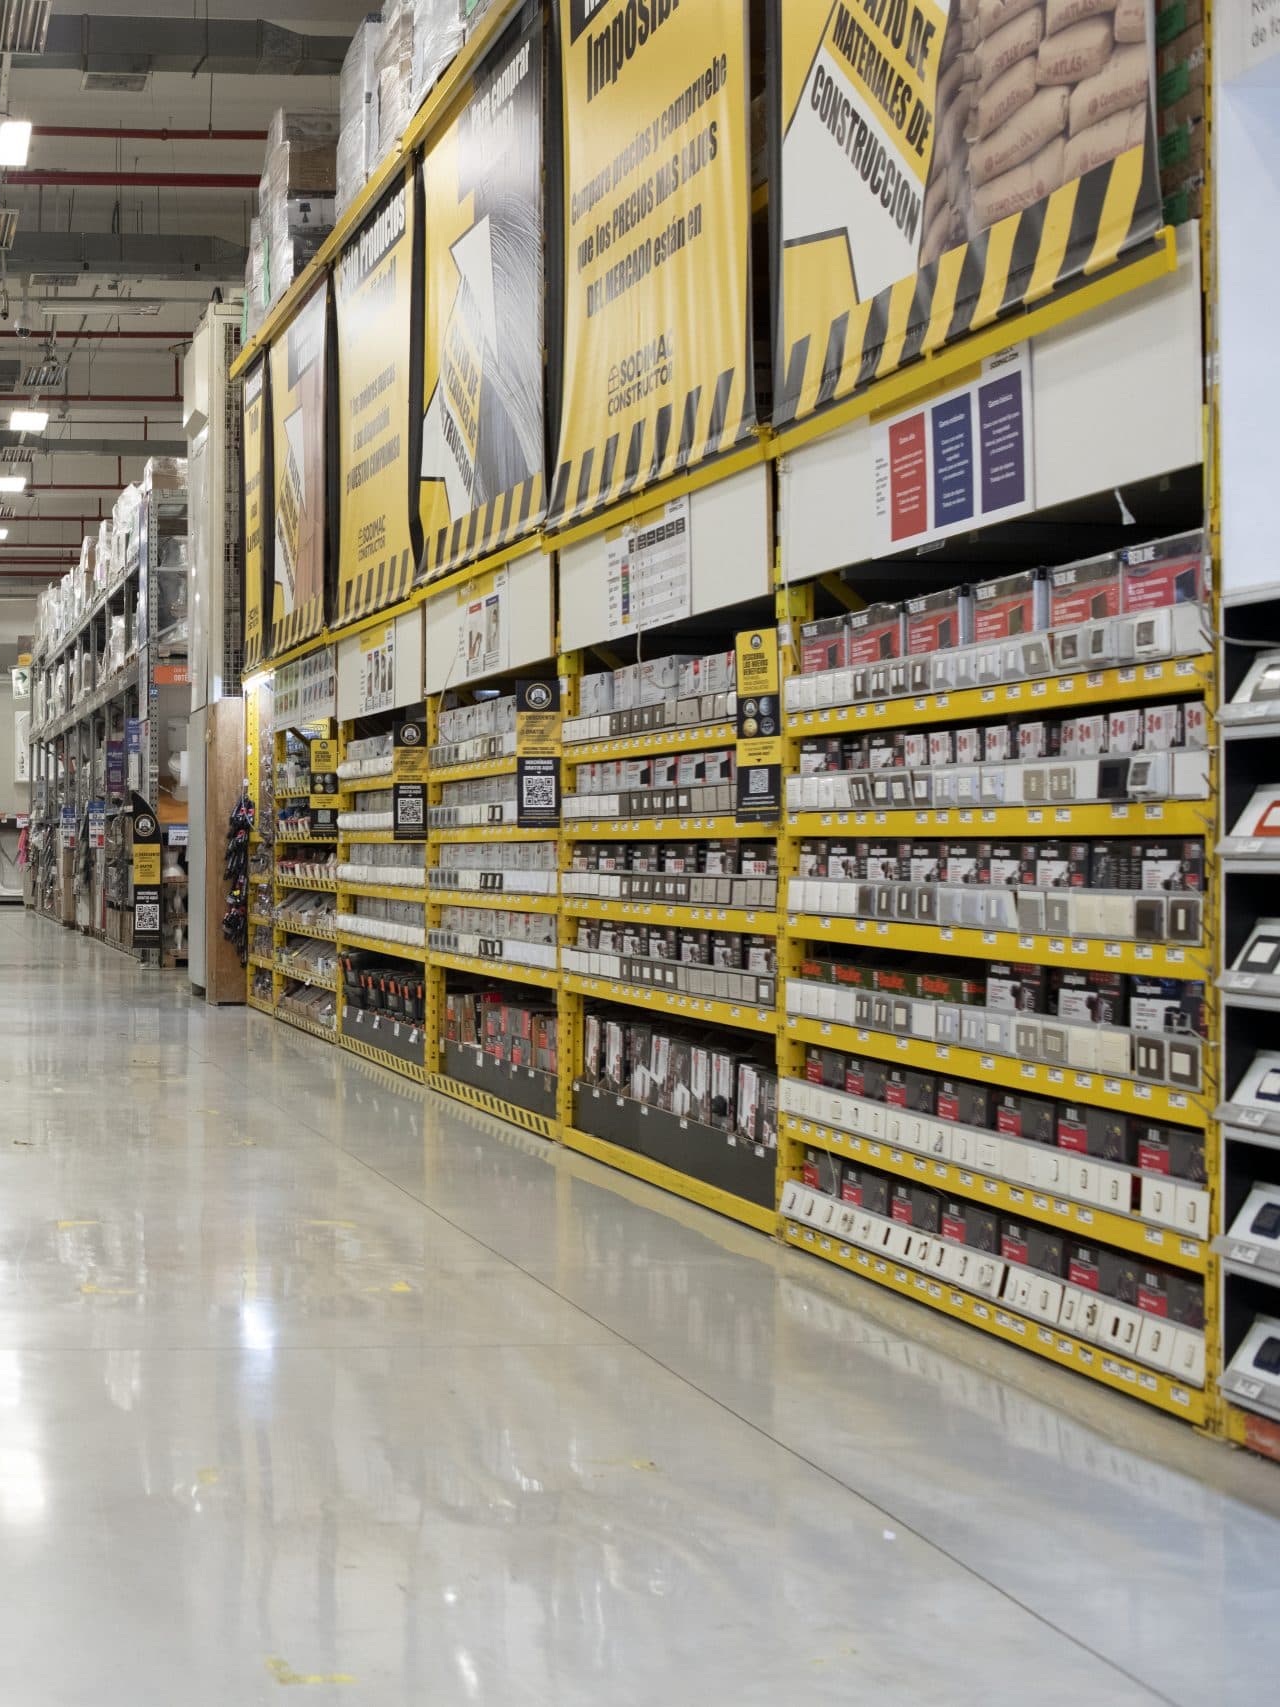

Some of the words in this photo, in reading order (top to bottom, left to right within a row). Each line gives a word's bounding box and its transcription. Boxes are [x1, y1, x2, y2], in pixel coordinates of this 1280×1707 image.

[587, 0, 680, 104] Imposib
[661, 53, 727, 141] compruebe
[832, 2, 912, 131] MATERIALES
[905, 97, 933, 158] DE
[596, 221, 610, 257] los
[612, 177, 654, 243] PRECIOS
[681, 121, 717, 185] BAJOS
[810, 64, 921, 246] CONSTRUCCION
[606, 237, 651, 304] MERCADO
[654, 215, 685, 267] están
[688, 203, 702, 241] en
[362, 514, 386, 543] SODIMAC
